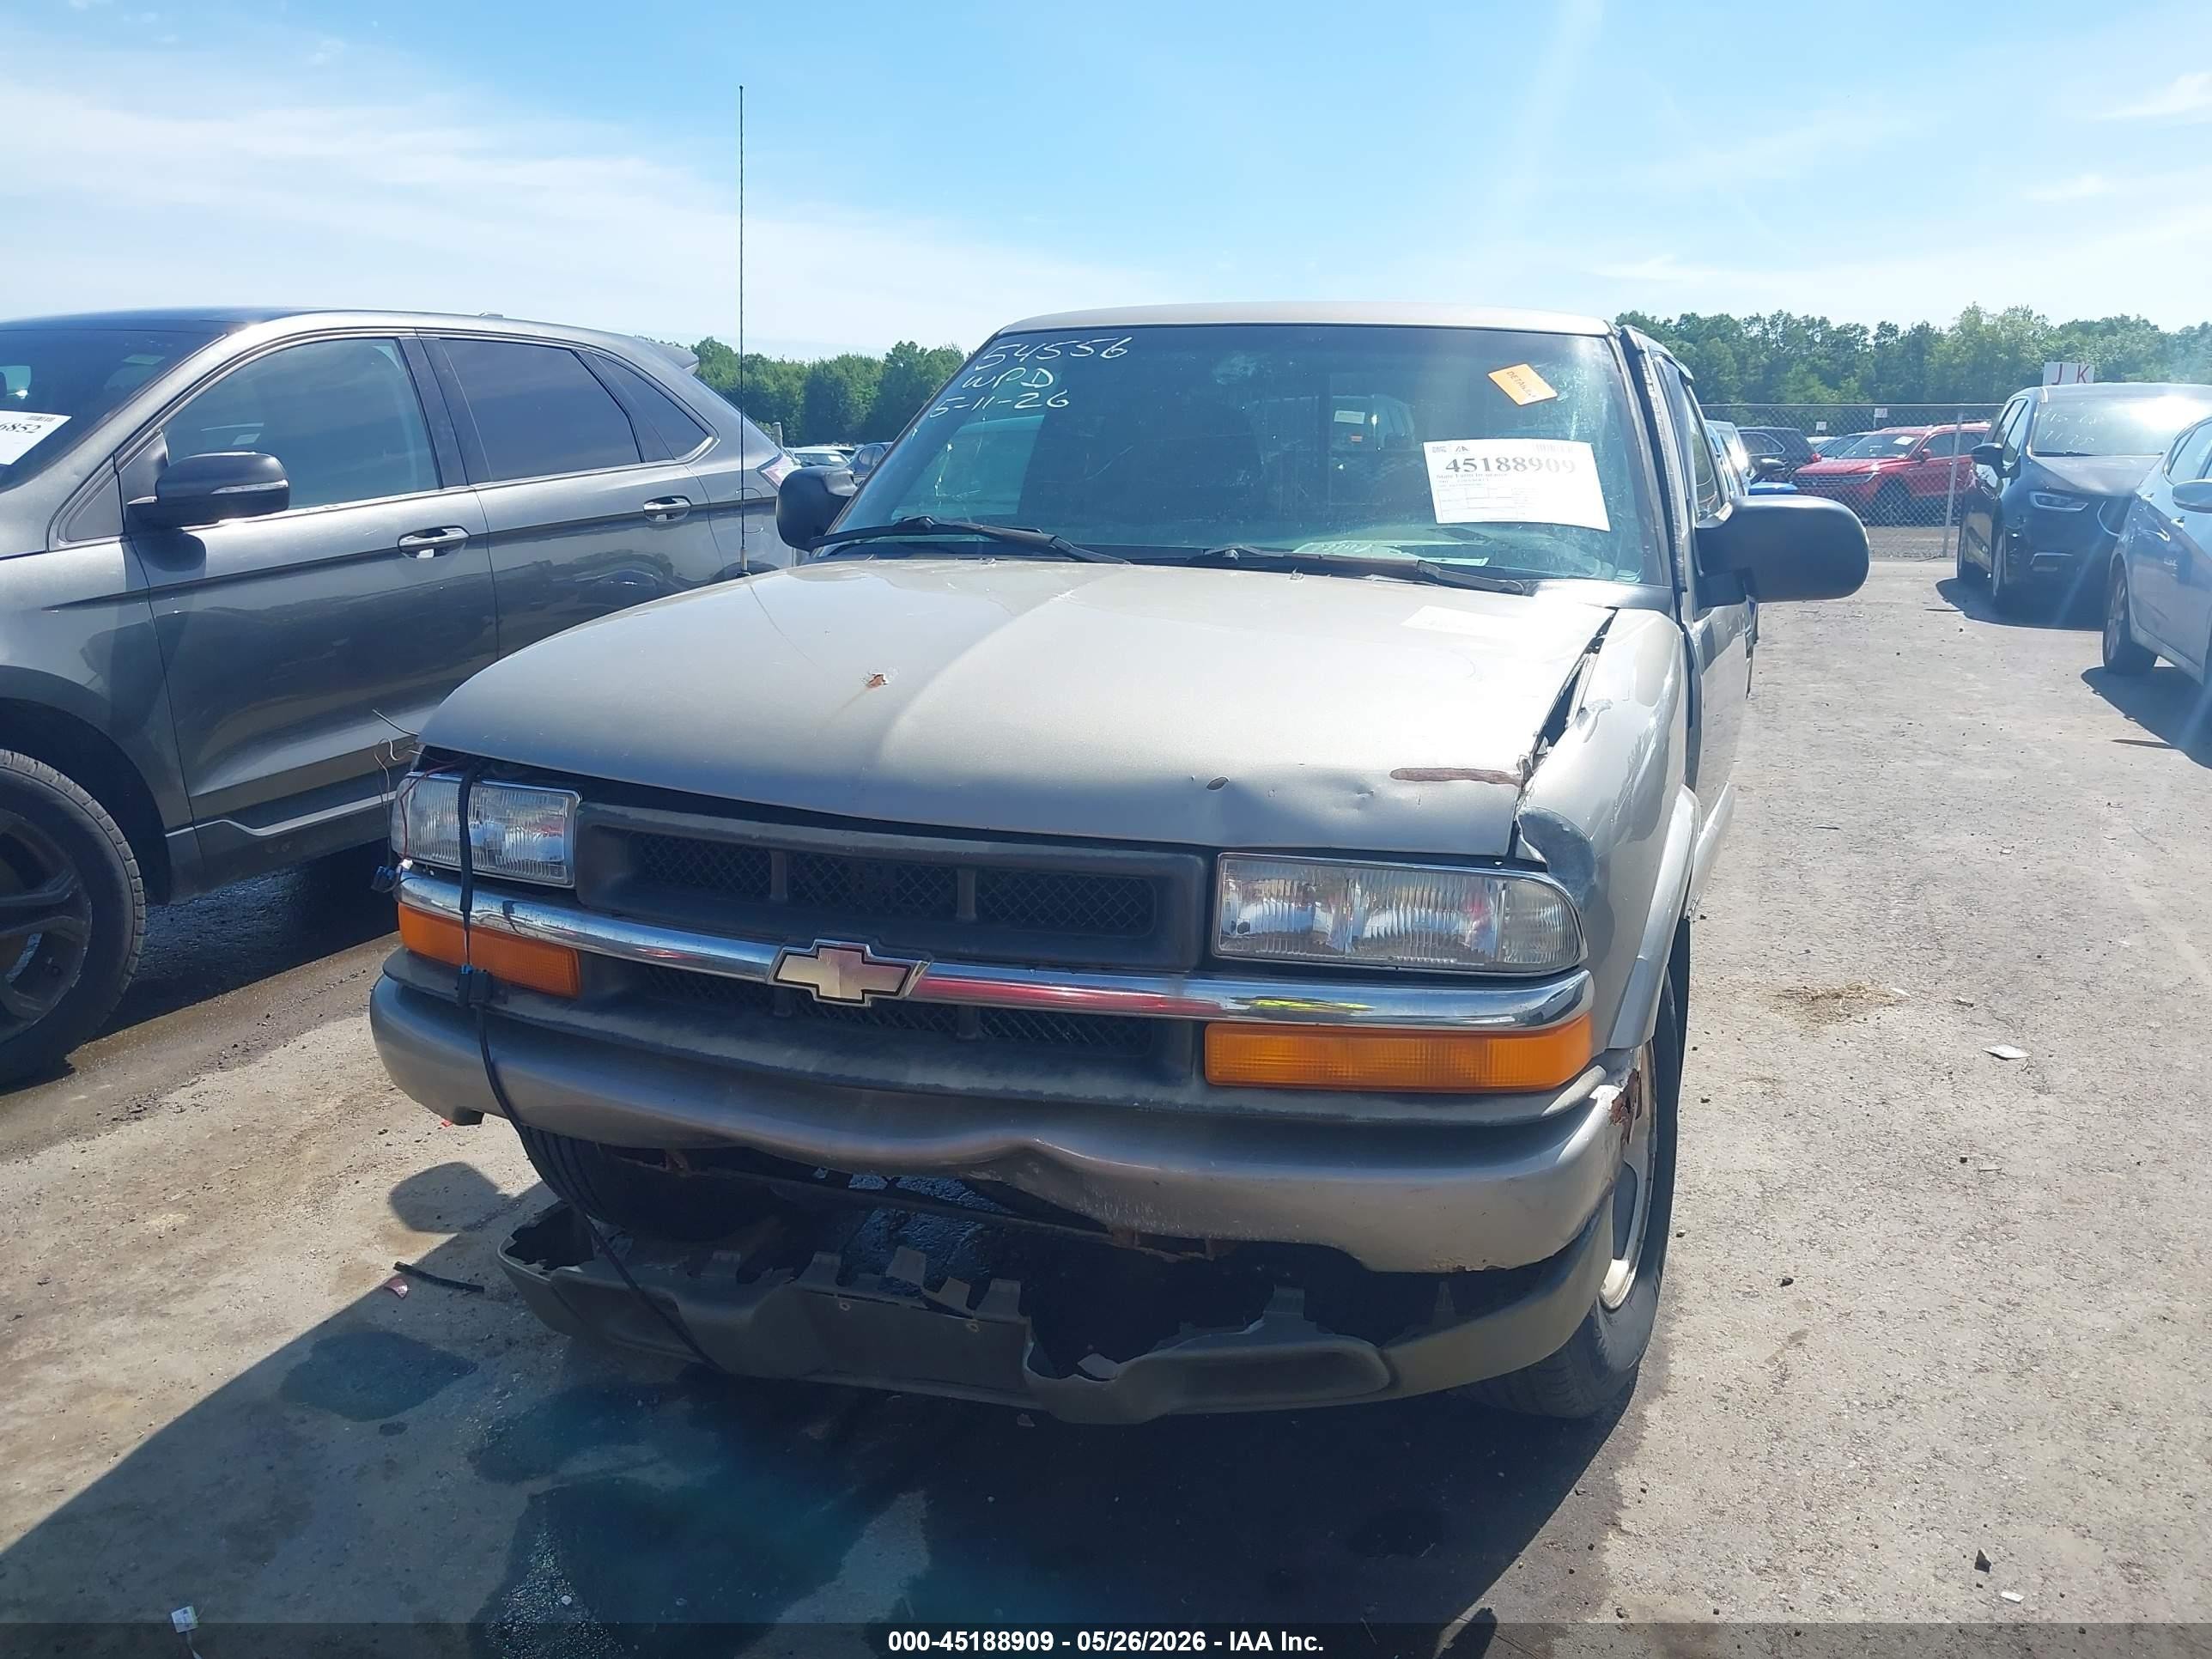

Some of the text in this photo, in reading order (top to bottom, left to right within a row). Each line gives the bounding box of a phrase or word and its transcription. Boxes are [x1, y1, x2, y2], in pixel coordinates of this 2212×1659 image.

[975, 337, 1133, 371] 54556
[2051, 363, 2090, 385] J K
[929, 389, 1070, 418] 5-11-26
[1444, 456, 1577, 473] 45188909
